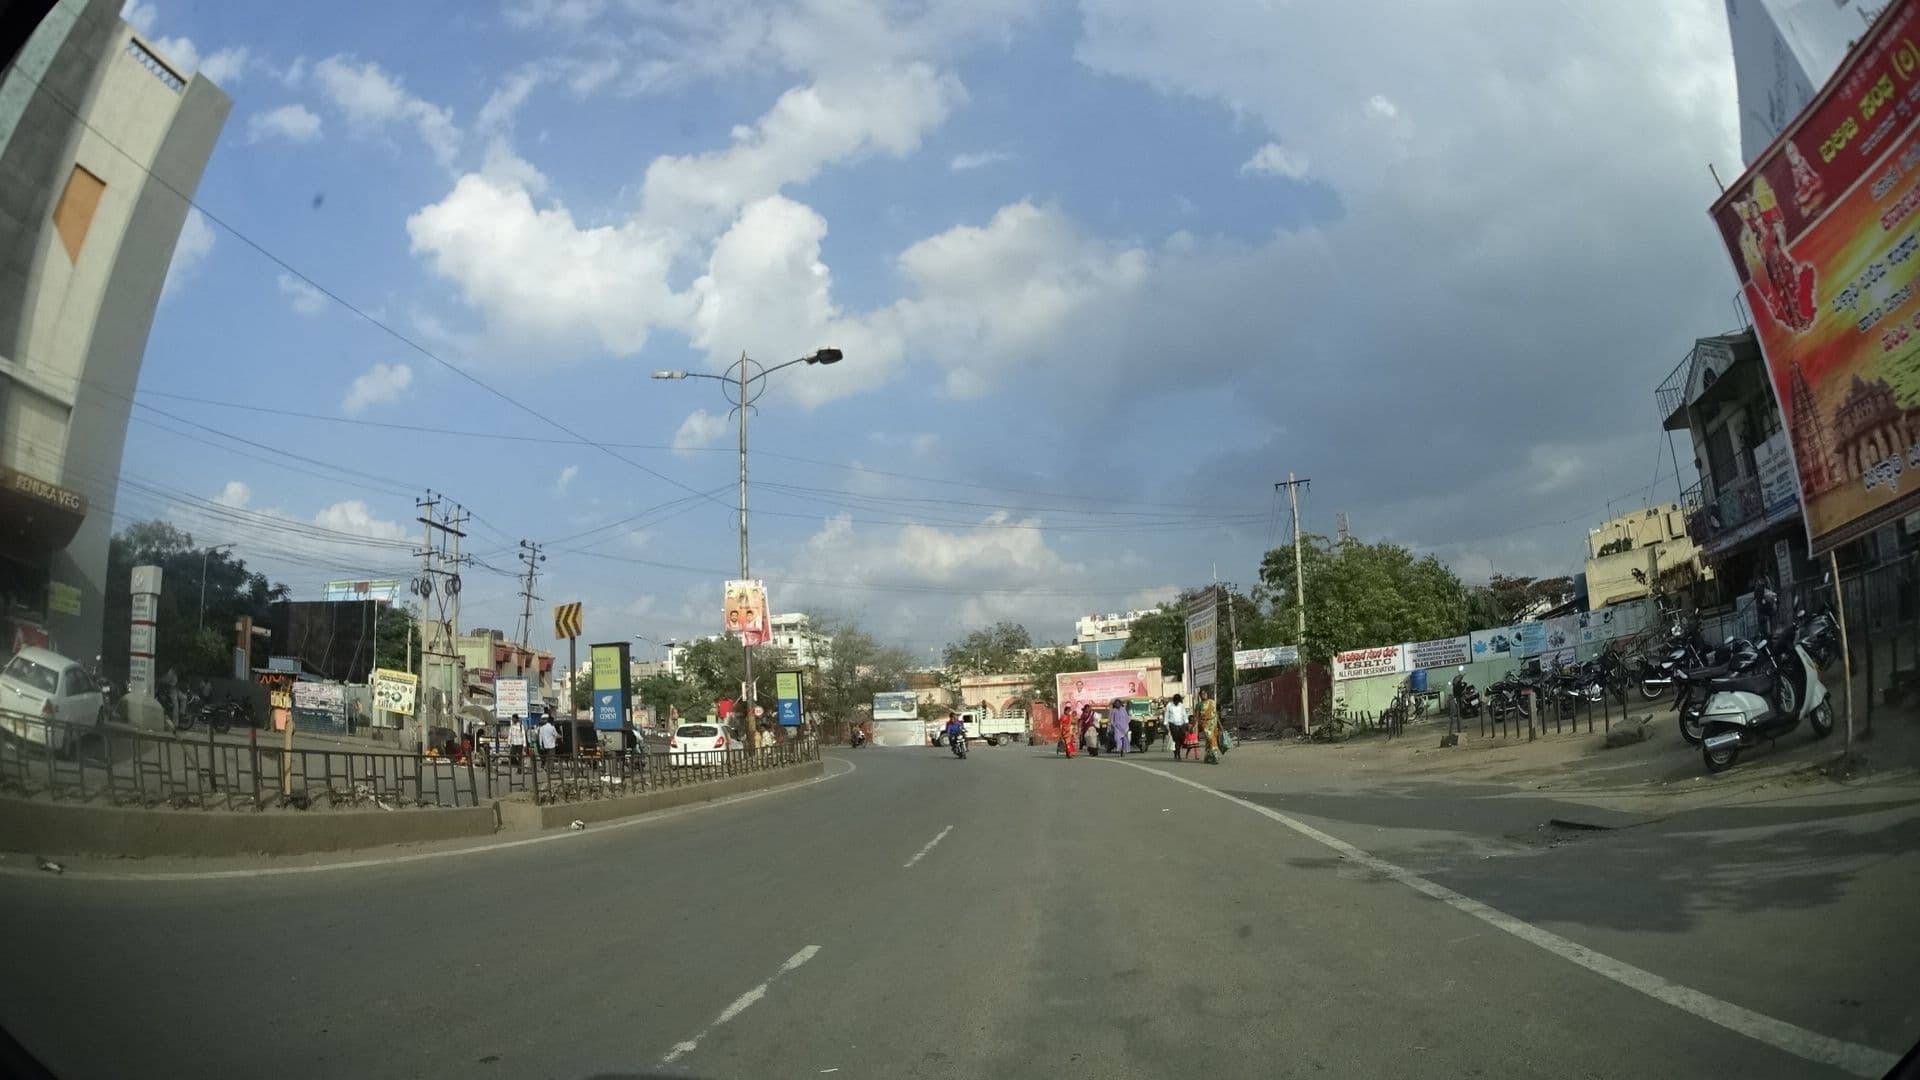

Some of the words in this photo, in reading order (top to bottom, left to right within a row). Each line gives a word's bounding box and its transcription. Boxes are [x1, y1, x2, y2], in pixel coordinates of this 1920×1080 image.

[59, 491, 80, 508] VEG
[1348, 669, 1362, 677] FLIGHT
[1364, 666, 1396, 675] RESERVATION
